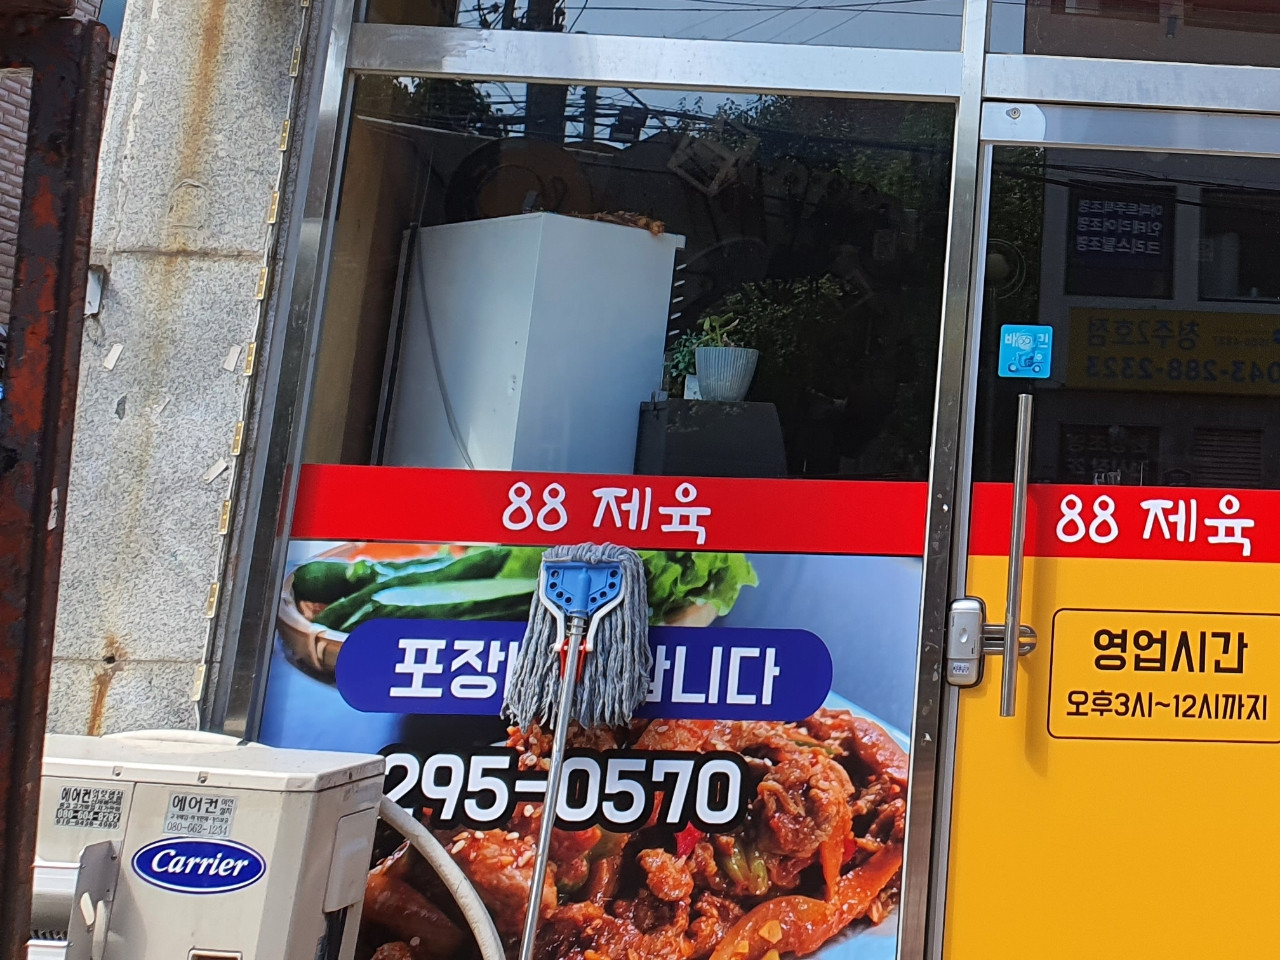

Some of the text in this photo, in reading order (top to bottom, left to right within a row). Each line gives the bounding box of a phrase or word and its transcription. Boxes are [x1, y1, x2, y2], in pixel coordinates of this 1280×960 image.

[501, 482, 712, 545] 88 제육
[1055, 494, 1255, 557] 88 제육
[1093, 628, 1248, 674] 영업시간
[1065, 689, 1267, 721] 오후3시~12시까지
[61, 786, 92, 803] 에어컨
[172, 795, 219, 814] 에어컨
[384, 753, 742, 825] 295-0570
[151, 848, 250, 878] Carrier
